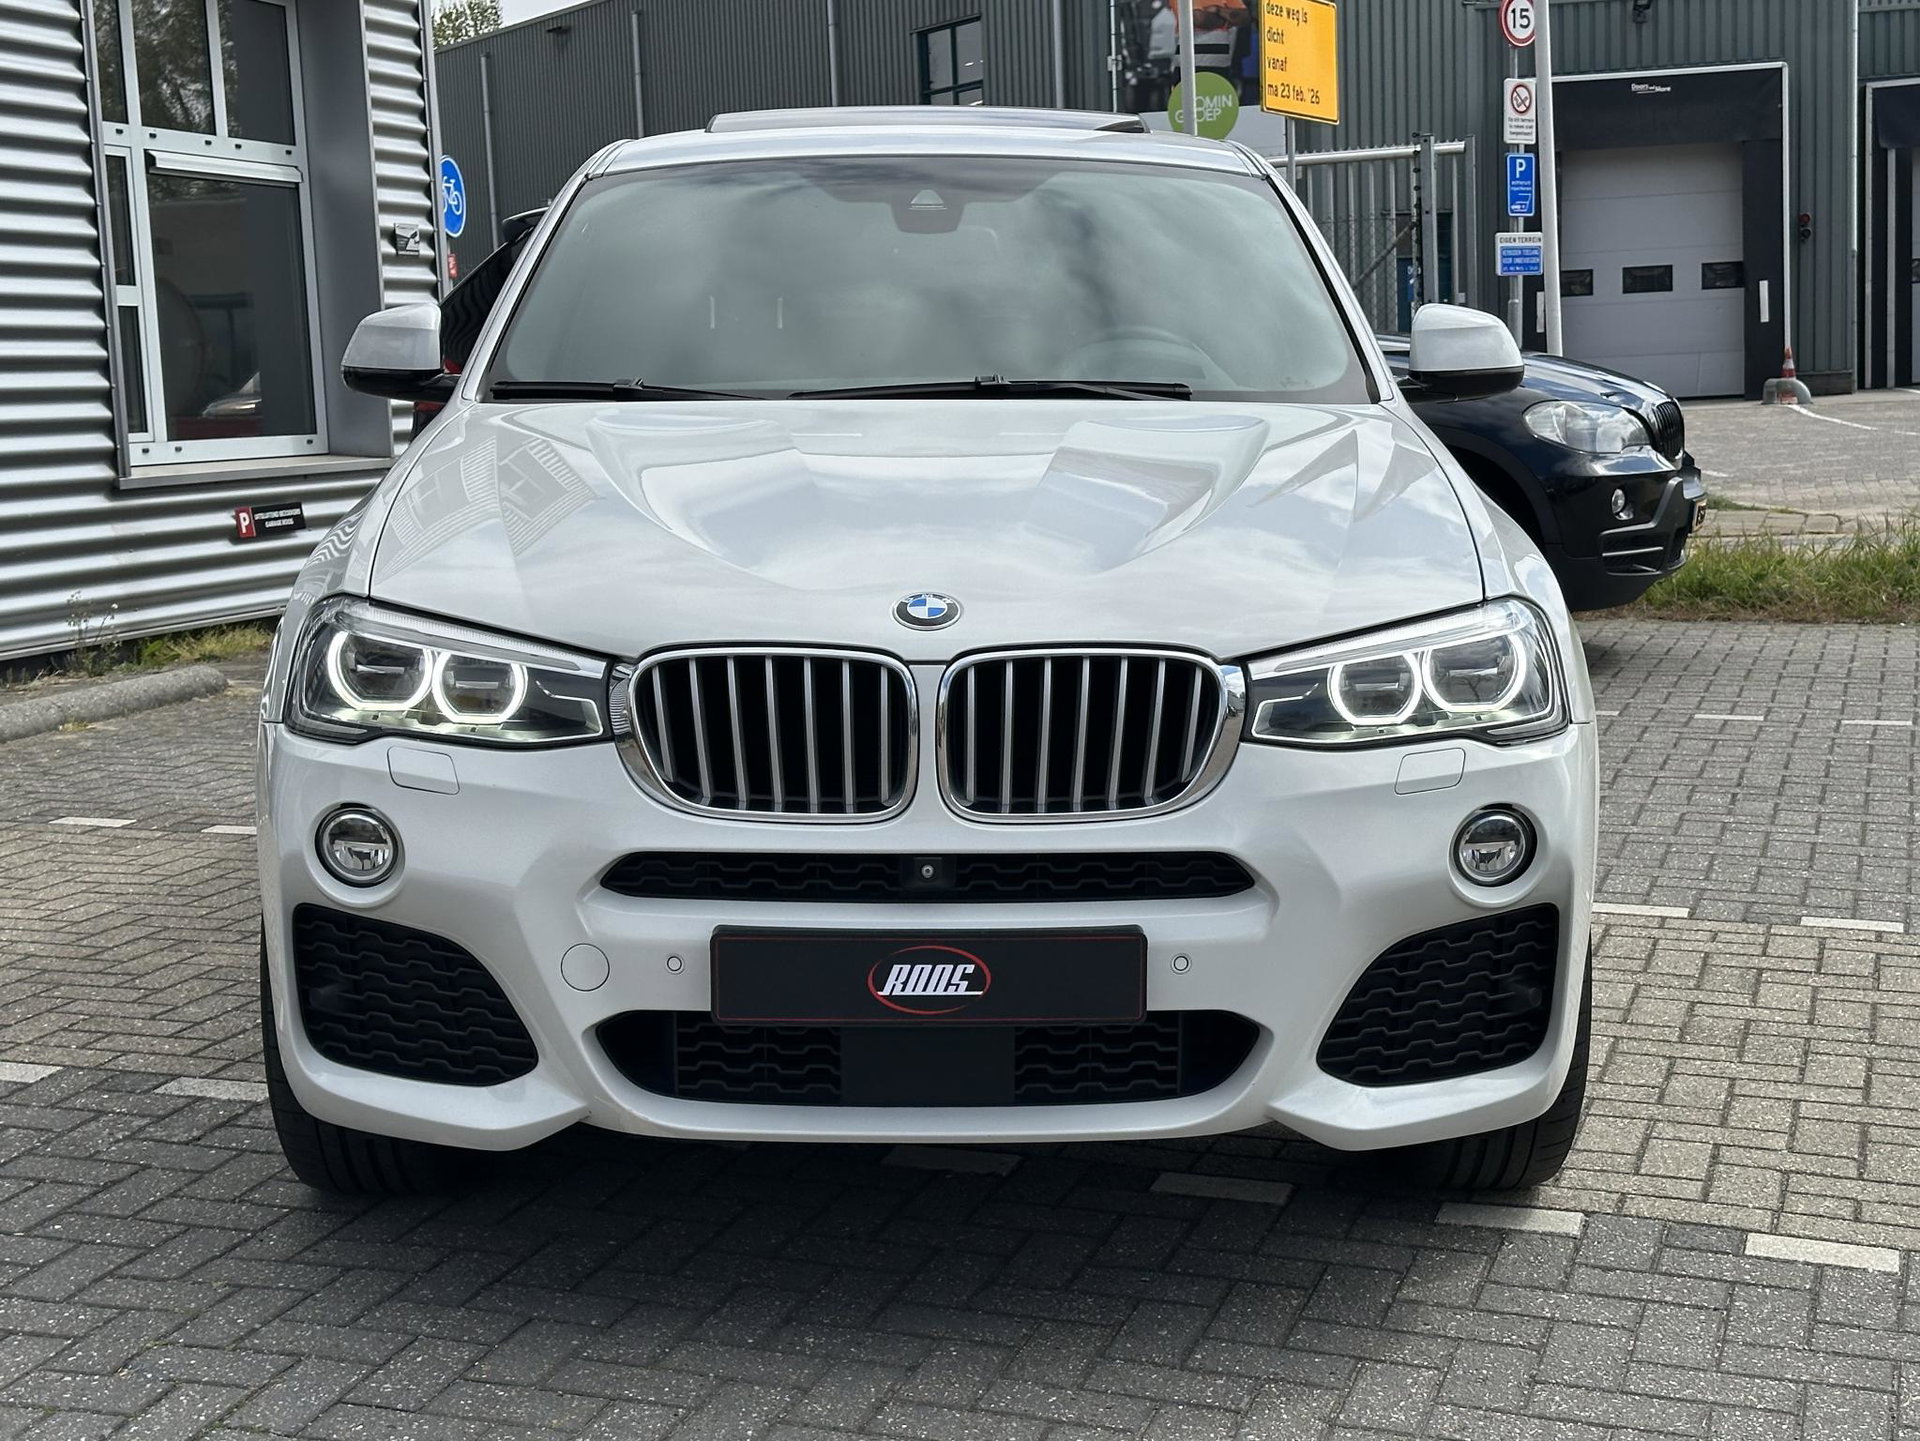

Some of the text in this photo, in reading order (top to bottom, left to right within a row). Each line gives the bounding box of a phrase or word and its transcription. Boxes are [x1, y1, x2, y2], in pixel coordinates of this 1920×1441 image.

[1266, 0, 1308, 26] deze weg is
[1510, 8, 1531, 29] 15
[1267, 27, 1284, 44] dicht
[1267, 57, 1287, 72] vanaf
[1194, 95, 1232, 108] OMIN
[1267, 84, 1278, 97] ma
[1280, 83, 1291, 99] 23
[1292, 85, 1306, 102] feb.
[1175, 109, 1221, 123] GOEP
[1516, 159, 1526, 178] P
[239, 512, 250, 533] P
[881, 964, 976, 995] ROOS
